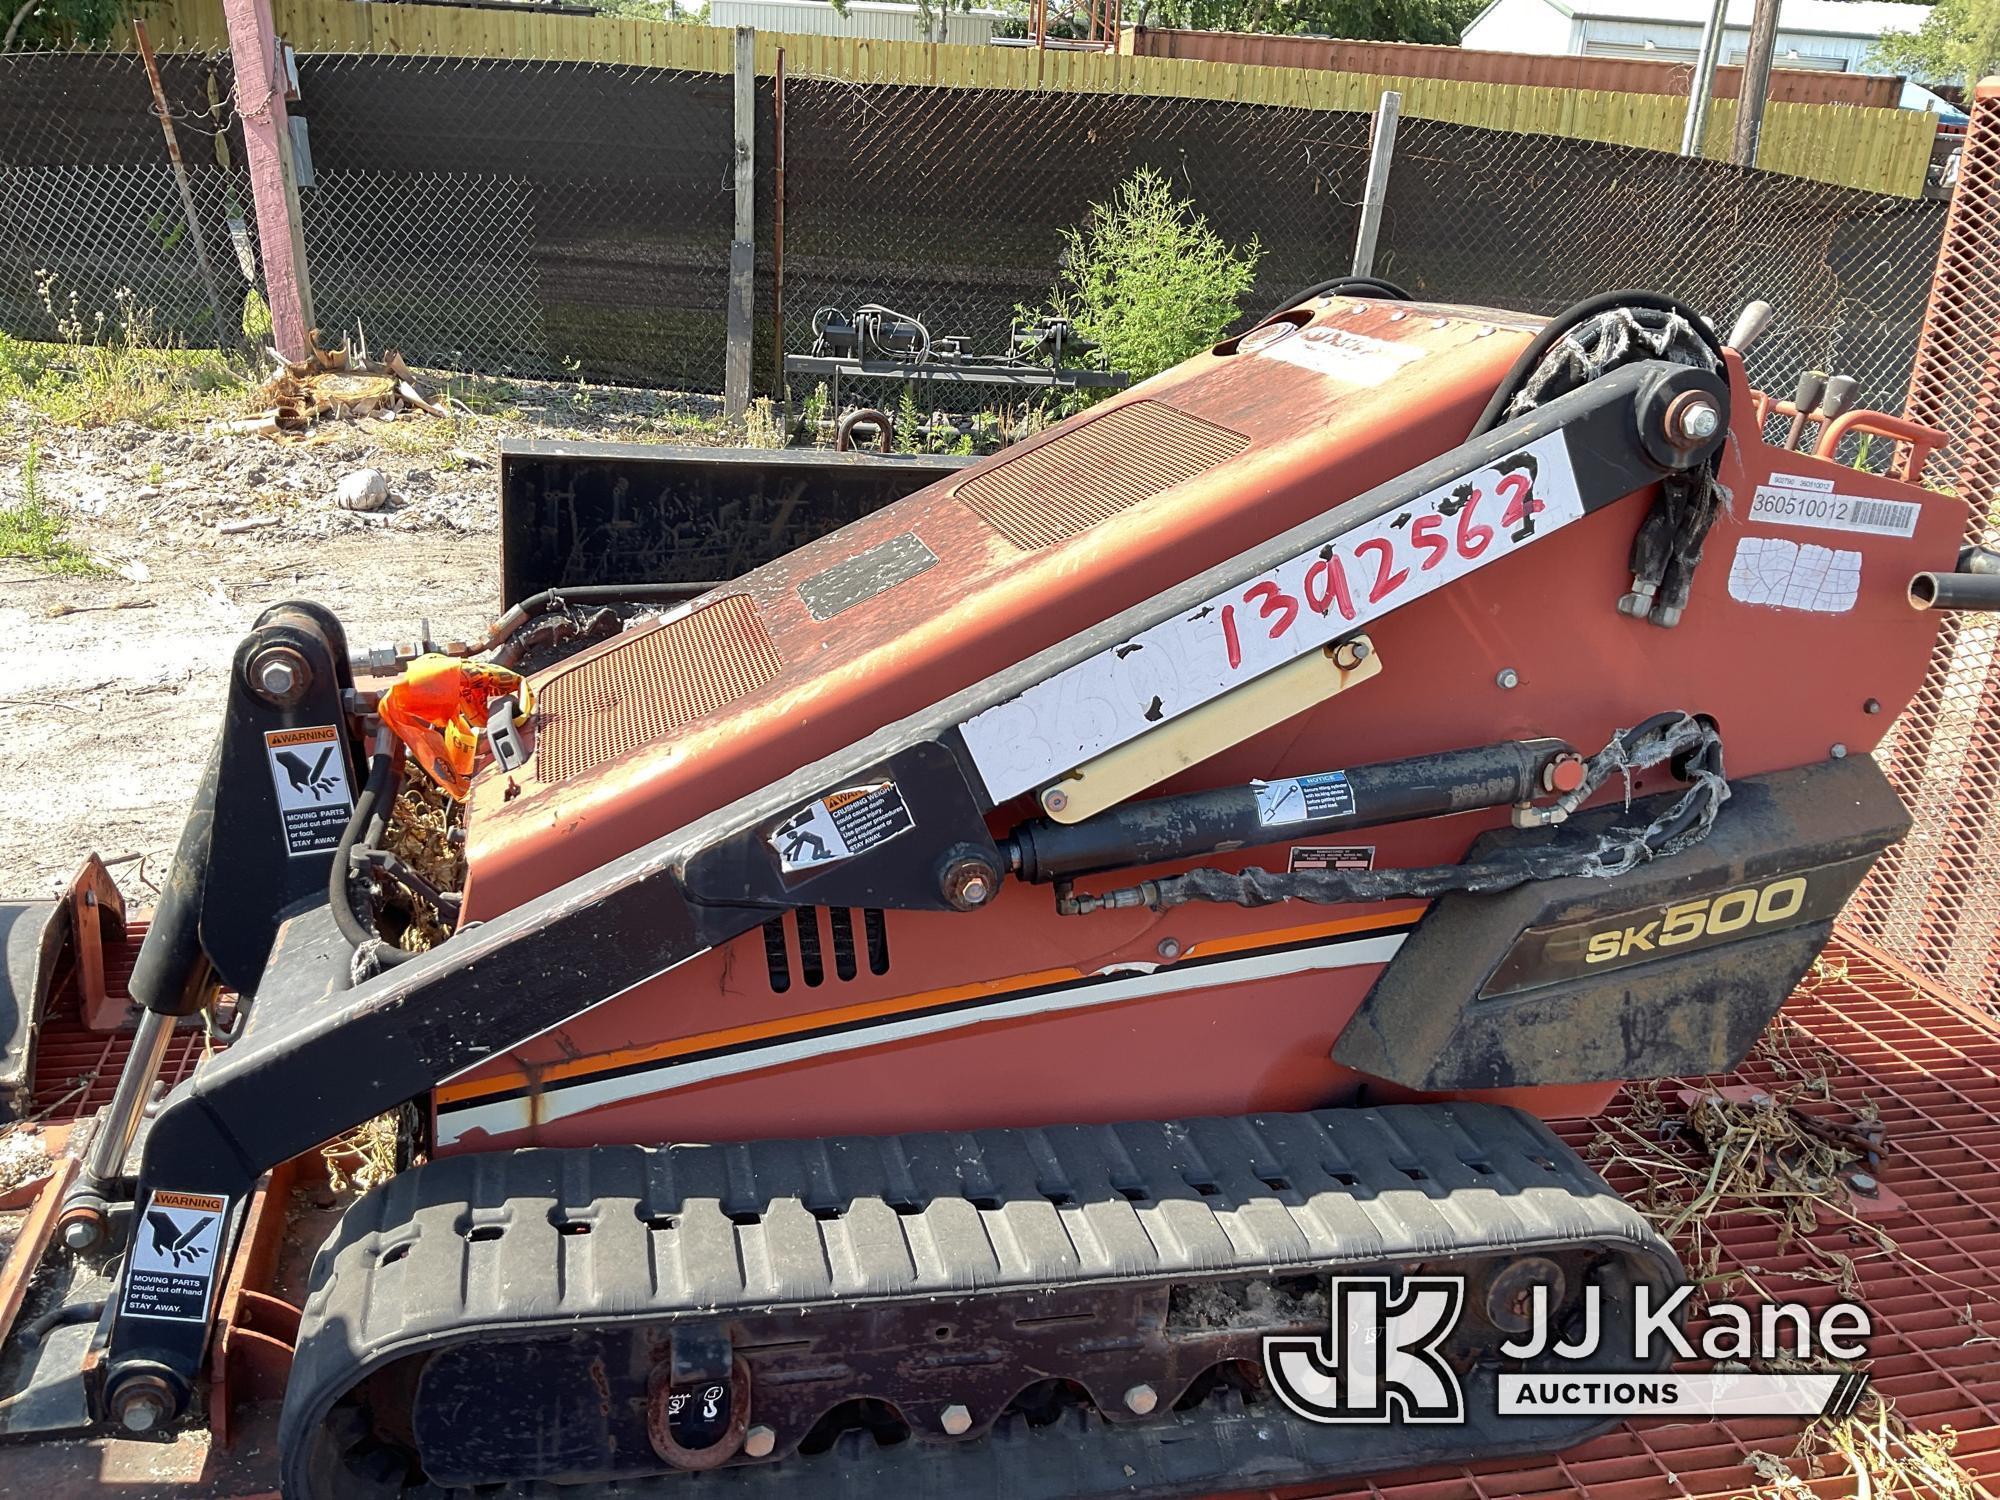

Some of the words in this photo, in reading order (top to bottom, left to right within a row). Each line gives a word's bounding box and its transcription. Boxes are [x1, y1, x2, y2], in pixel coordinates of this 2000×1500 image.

[1753, 494, 1849, 520] 360510012
[1221, 474, 1546, 669] 1392562
[282, 730, 334, 744] WARNING
[1306, 775, 1336, 784] NOTICE
[287, 812, 317, 821] MOVING
[320, 808, 345, 817] PARTS
[832, 797, 868, 818] CRUSHING
[836, 814, 852, 825] could
[852, 806, 869, 817] cause
[869, 798, 885, 809] death
[289, 822, 308, 830] could
[321, 818, 331, 826] off
[332, 816, 350, 824] hand
[842, 830, 855, 838] Use
[854, 820, 873, 834] proper
[873, 806, 904, 825] procedures
[846, 815, 867, 829] serious
[846, 836, 858, 845] and
[857, 822, 887, 840] equipment
[292, 839, 311, 848] STAY
[314, 836, 338, 845] AWAY.
[849, 841, 865, 852] STAY
[1585, 877, 1808, 964] SK500
[160, 1195, 220, 1209] WARNING
[134, 1275, 169, 1285] MOVING
[172, 1278, 201, 1287] PARTS
[132, 1284, 155, 1292] could
[182, 1288, 203, 1296] hand
[129, 1302, 151, 1310] STAY
[155, 1304, 182, 1312] AWAY.
